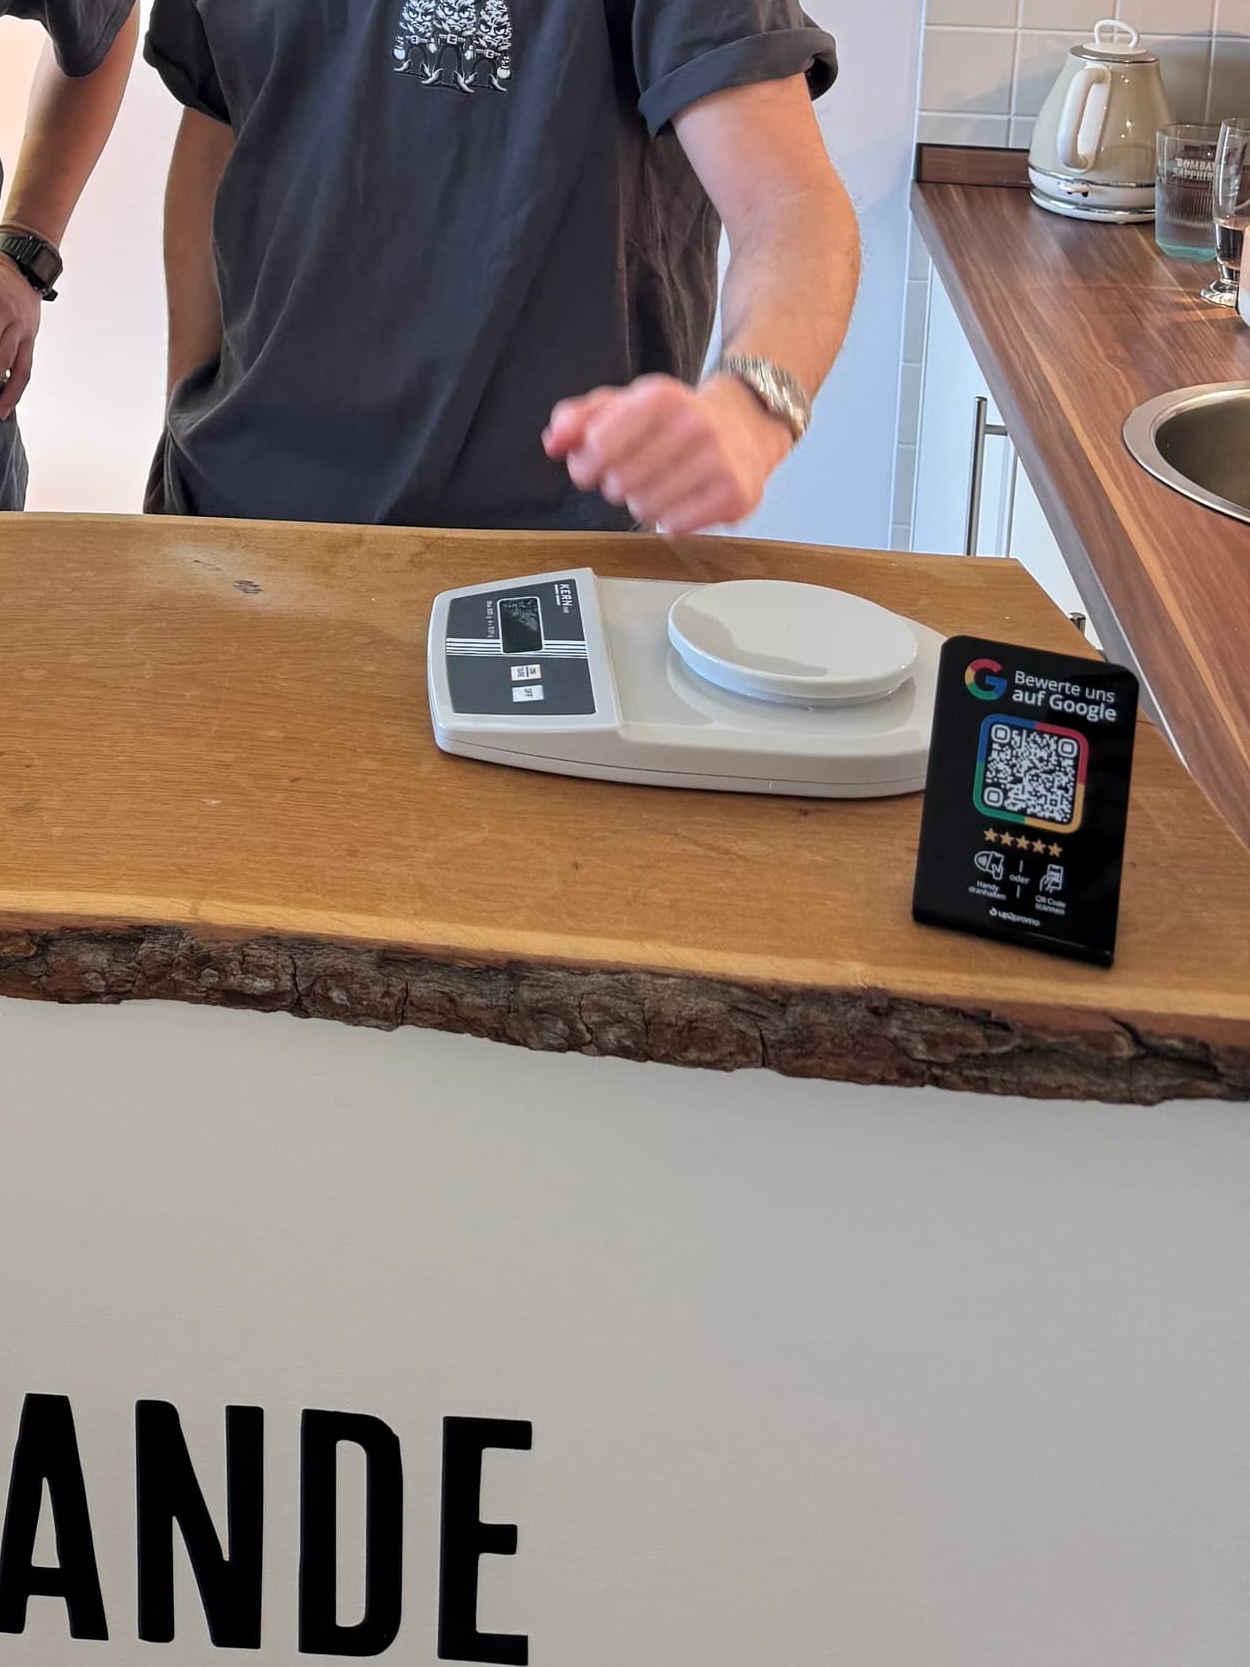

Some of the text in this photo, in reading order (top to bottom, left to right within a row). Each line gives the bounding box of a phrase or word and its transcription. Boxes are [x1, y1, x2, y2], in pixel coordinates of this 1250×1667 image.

[1172, 167, 1214, 182] SAPPHIR
[1174, 157, 1215, 171] BOMBA
[559, 583, 573, 606] KERN
[1014, 670, 1116, 704] Bewerte uns
[1012, 688, 1118, 722] auf Google
